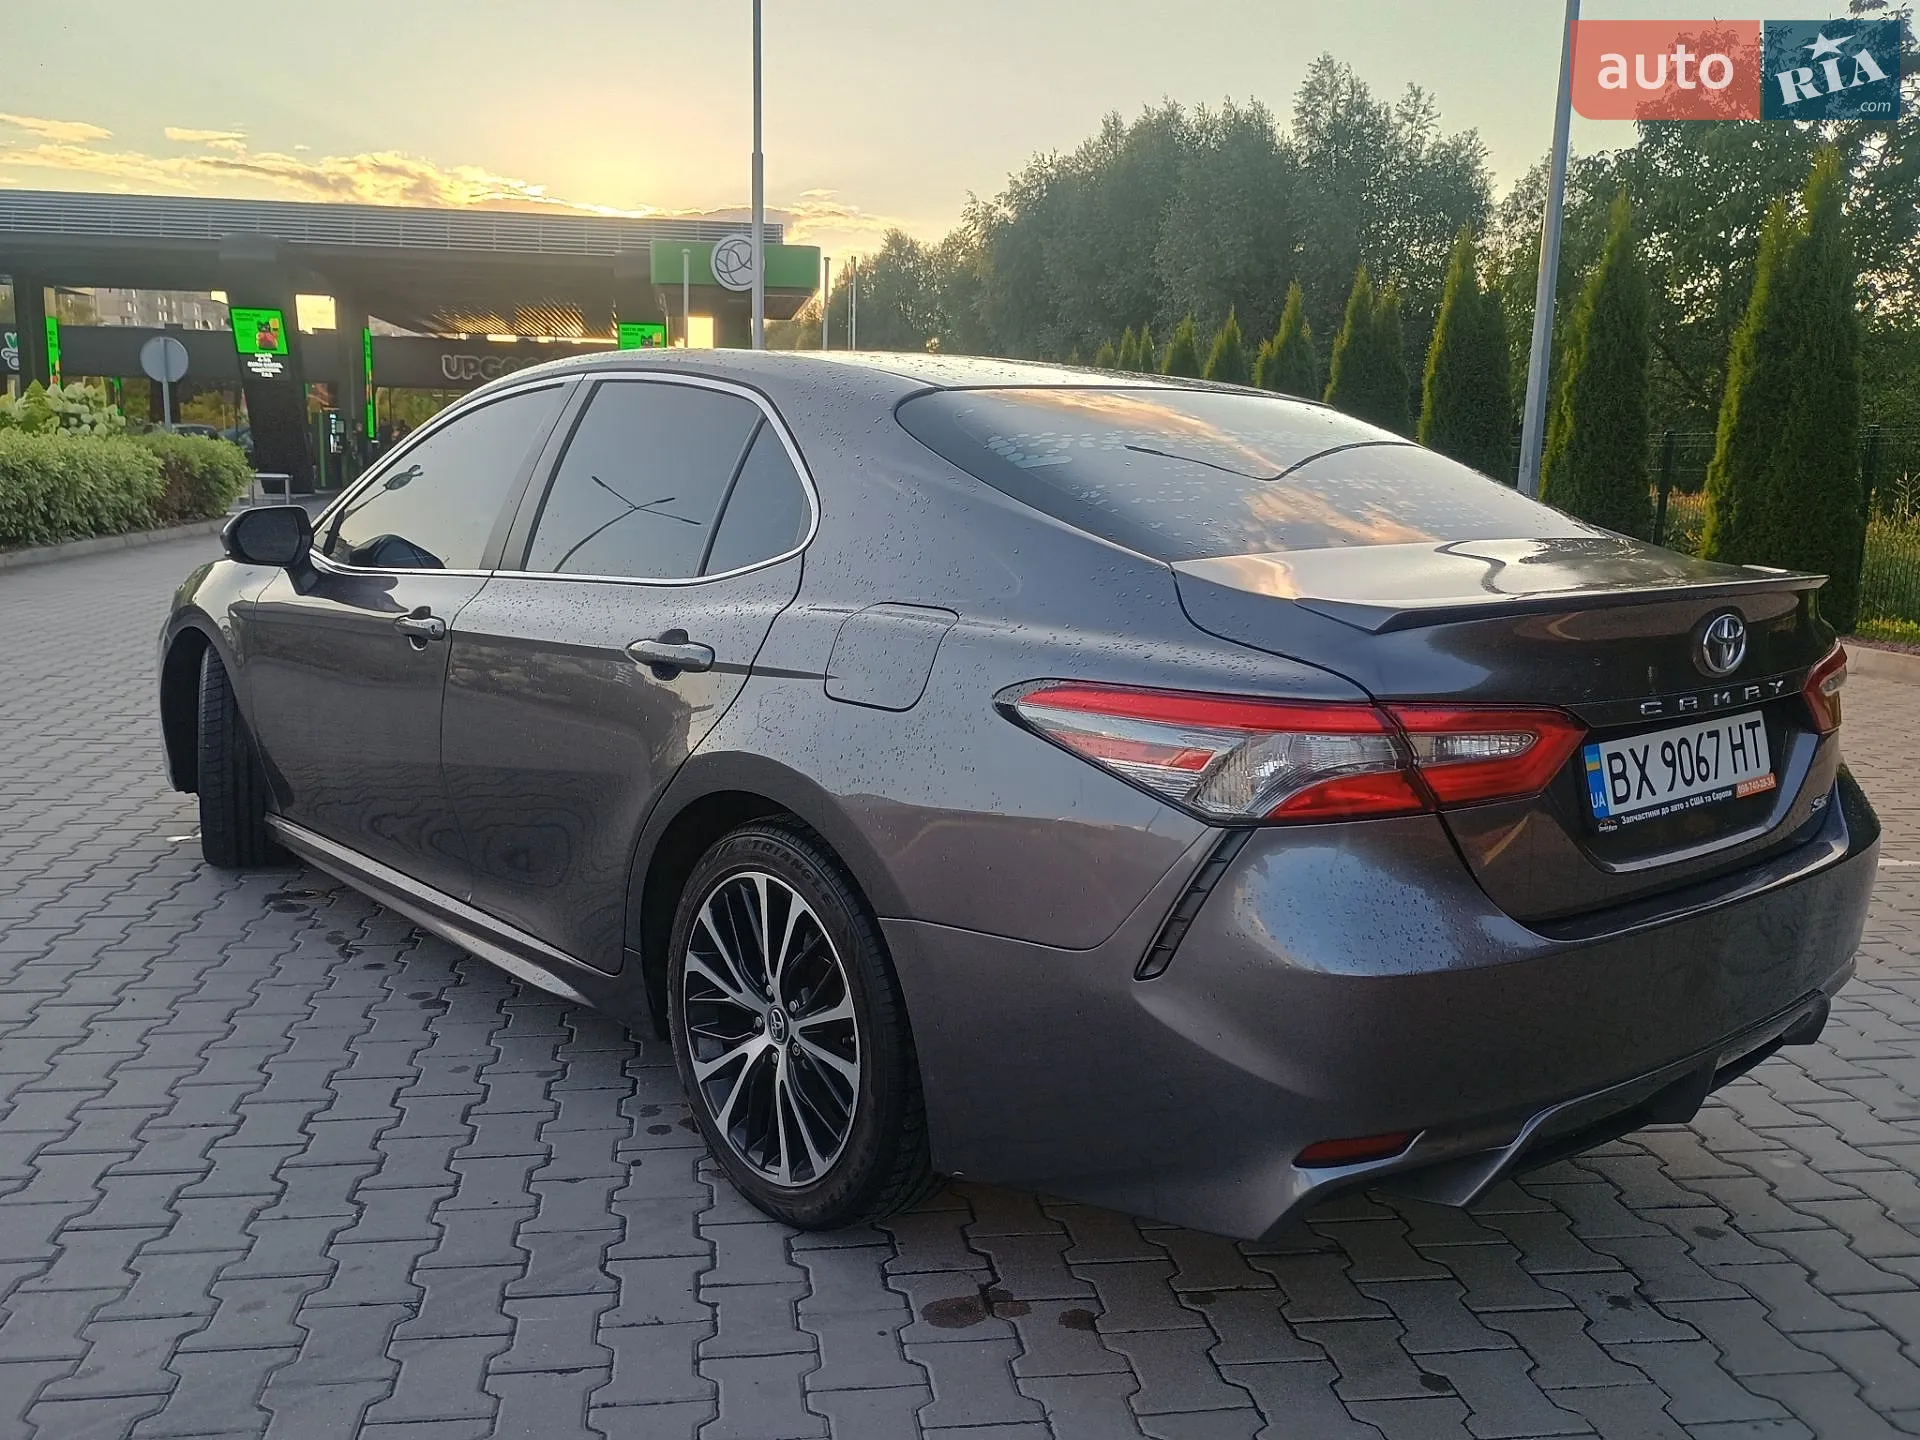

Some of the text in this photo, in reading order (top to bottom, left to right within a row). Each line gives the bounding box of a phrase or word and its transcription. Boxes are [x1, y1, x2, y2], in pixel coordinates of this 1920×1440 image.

[1640, 680, 1784, 715] CAMRY
[1606, 719, 1761, 806] BX 9067 HT
[1590, 791, 1607, 809] UA
[1689, 795, 1705, 808] США
